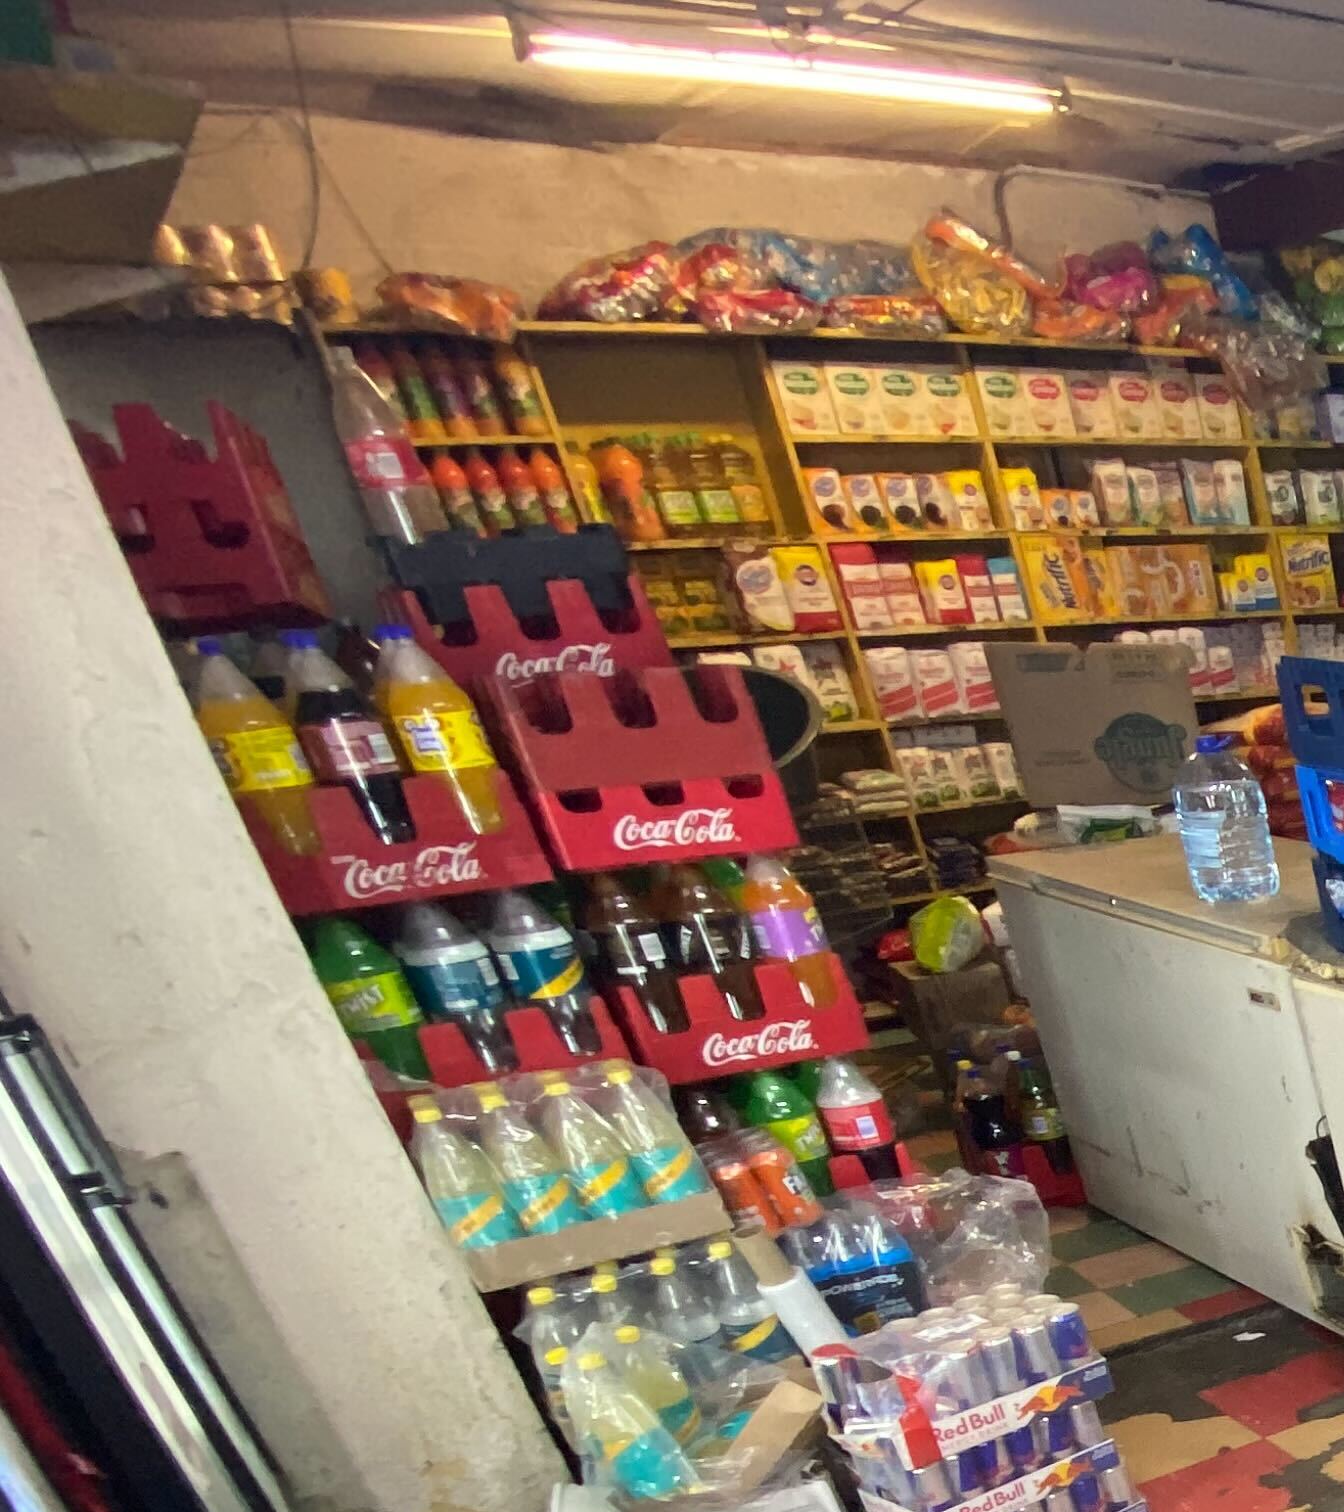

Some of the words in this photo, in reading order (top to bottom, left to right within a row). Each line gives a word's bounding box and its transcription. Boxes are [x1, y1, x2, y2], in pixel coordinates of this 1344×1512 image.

[612, 807, 737, 851] Coca-Cola
[344, 842, 481, 898] Coca-Cola
[702, 1019, 814, 1066] Coca-Cola
[932, 1418, 969, 1445] Red
[969, 1402, 1006, 1430] Bull
[993, 1482, 1025, 1507] Bull
